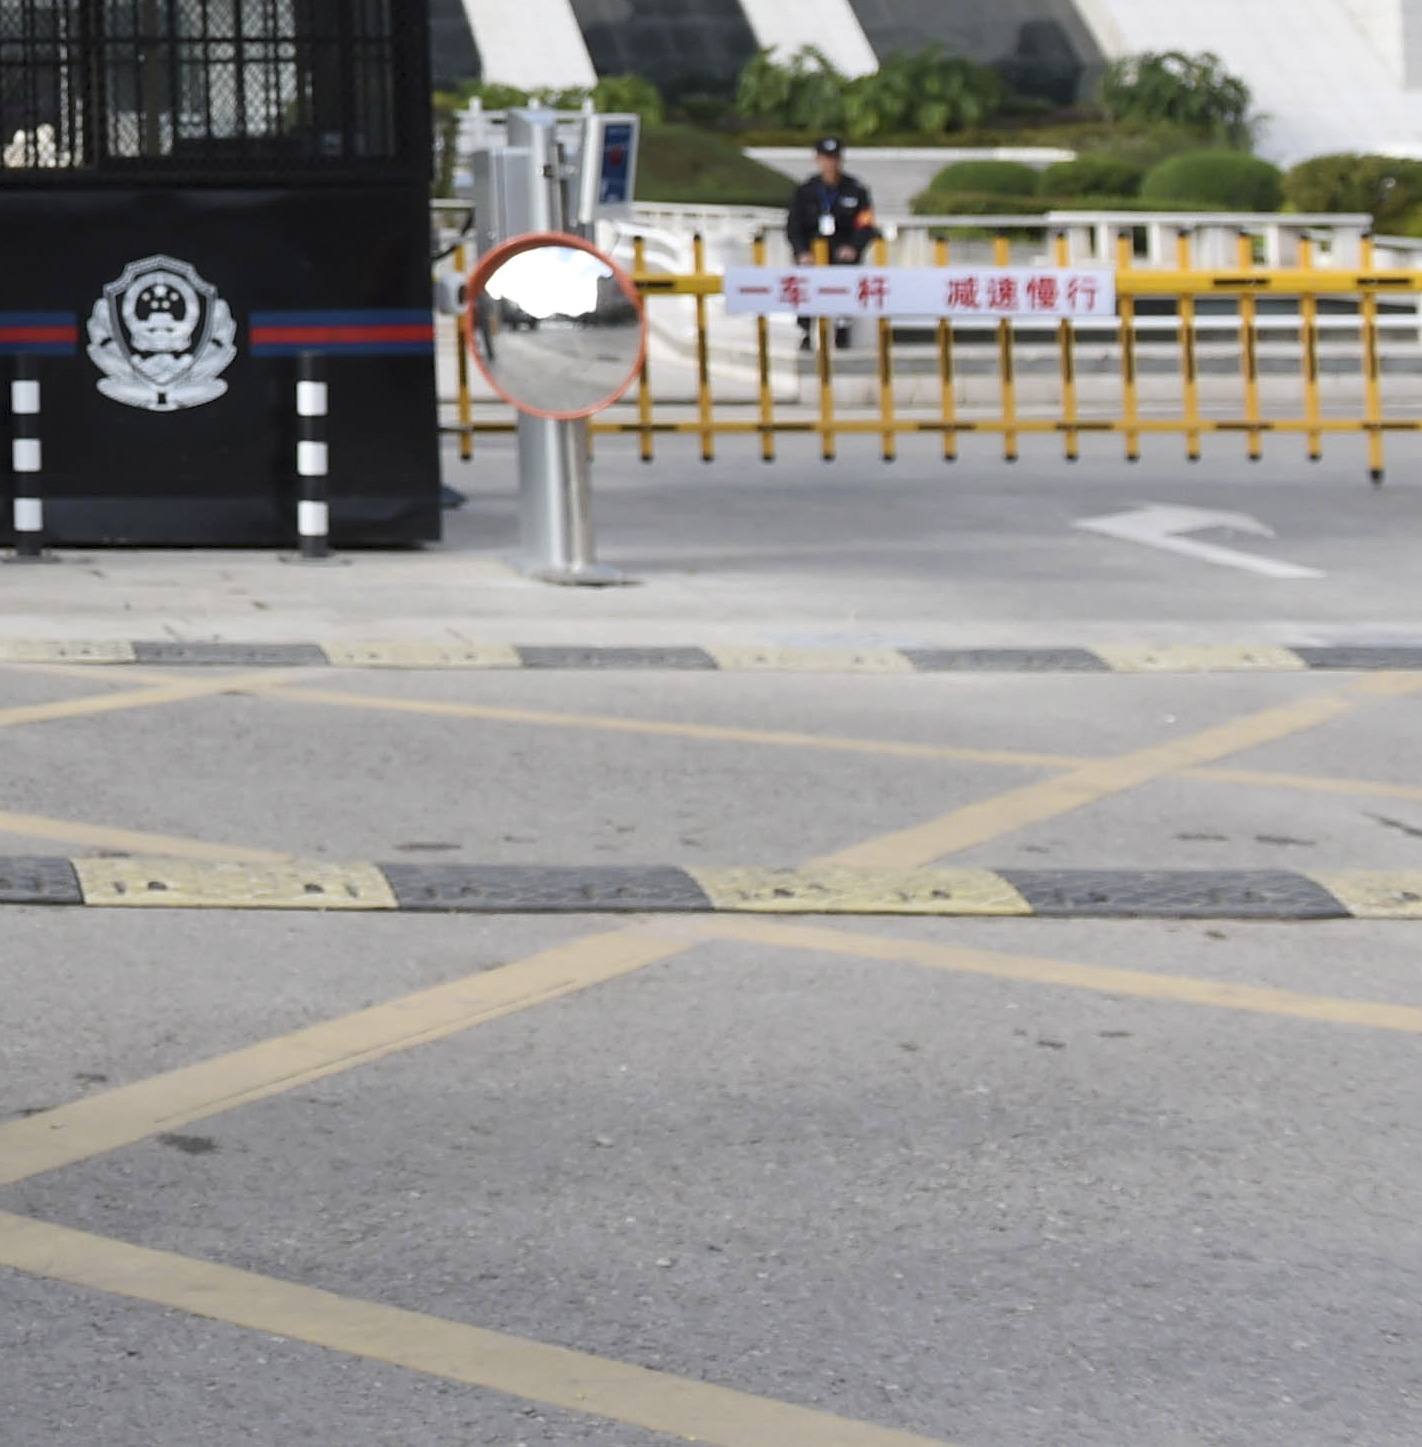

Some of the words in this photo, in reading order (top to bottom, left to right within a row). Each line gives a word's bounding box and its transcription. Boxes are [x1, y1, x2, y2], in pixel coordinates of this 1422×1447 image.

[739, 275, 890, 309] 一车一杆
[947, 275, 1098, 311] 减速慢行
